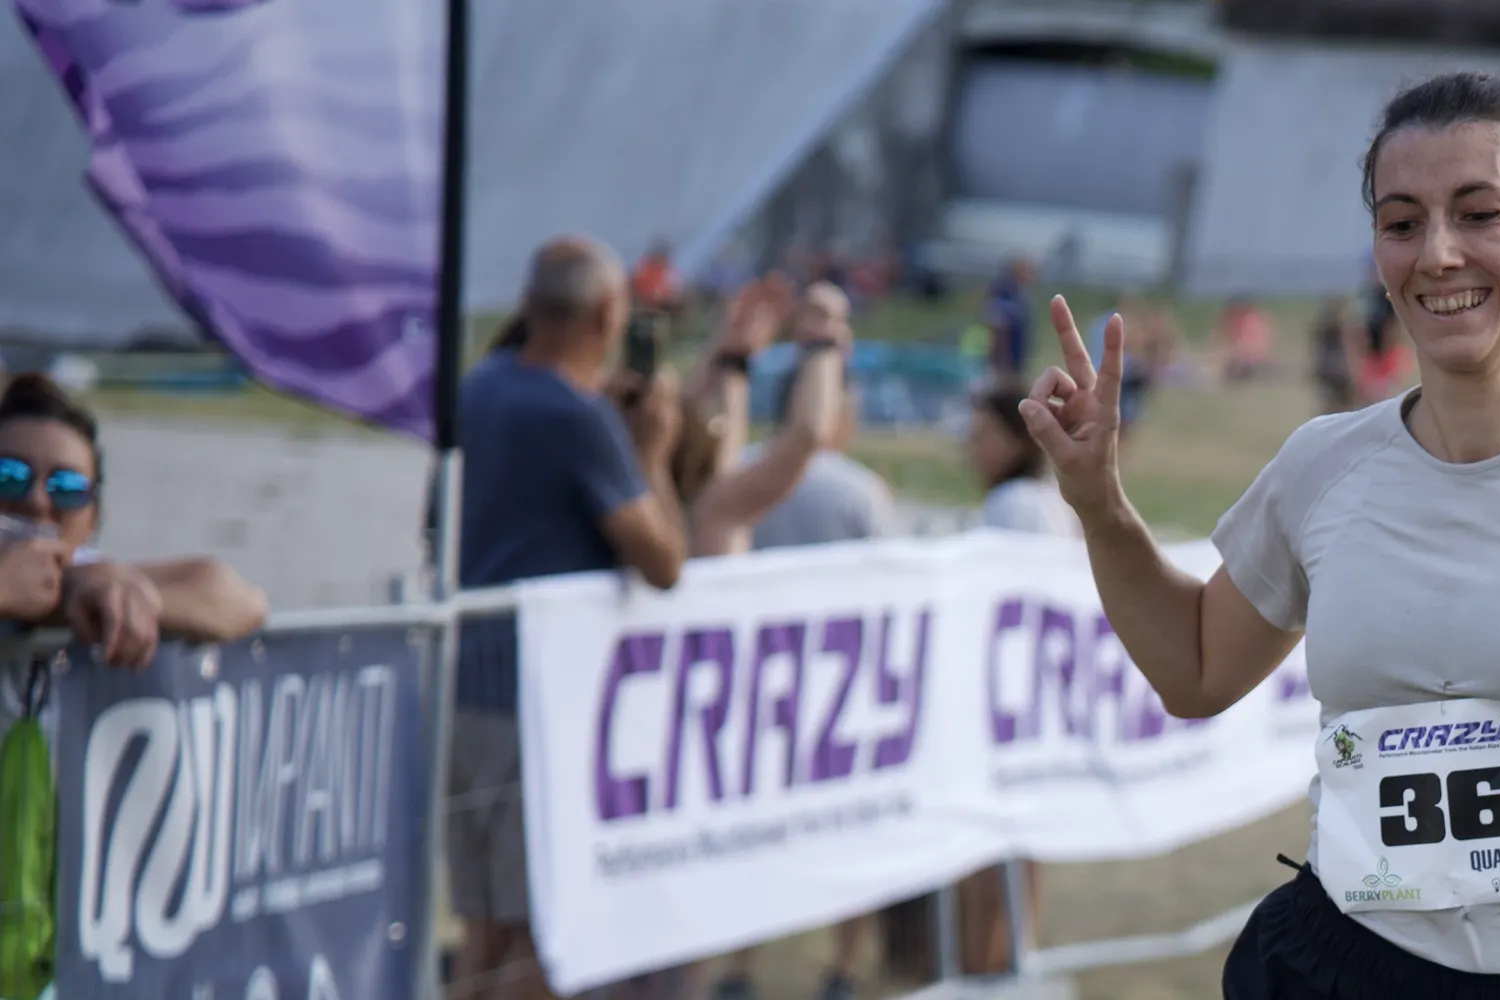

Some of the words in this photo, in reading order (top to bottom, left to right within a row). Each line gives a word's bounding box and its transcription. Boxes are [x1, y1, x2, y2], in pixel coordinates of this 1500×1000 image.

[594, 609, 932, 822] CRAZY
[987, 597, 1212, 745] CRA
[1345, 888, 1421, 902] BERRYPLANT
